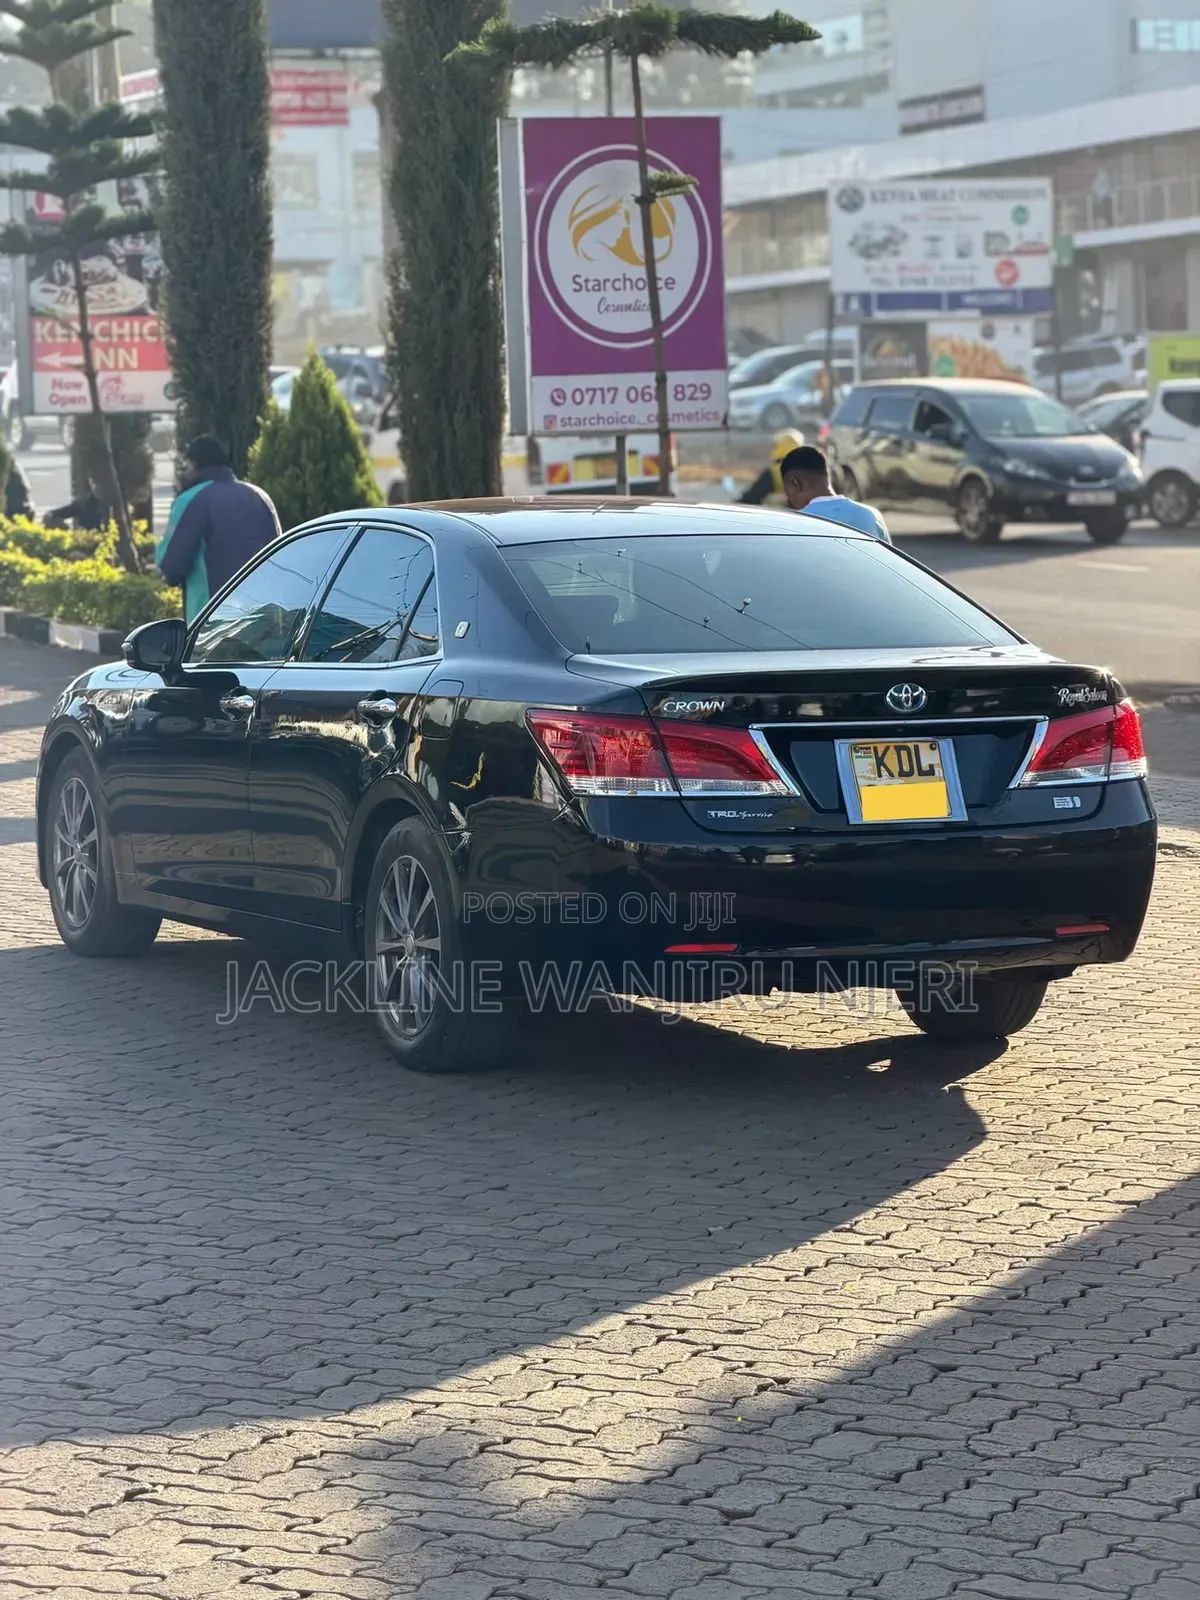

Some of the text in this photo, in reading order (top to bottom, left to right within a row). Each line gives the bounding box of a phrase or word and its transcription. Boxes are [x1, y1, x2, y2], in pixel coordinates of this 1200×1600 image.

[571, 272, 676, 293] Starchoce
[92, 347, 138, 369] NN
[51, 379, 83, 390] Now
[571, 383, 711, 406] 0717 06 829
[48, 393, 87, 406] Open
[663, 700, 725, 713] CROWN
[873, 745, 935, 778] KDL
